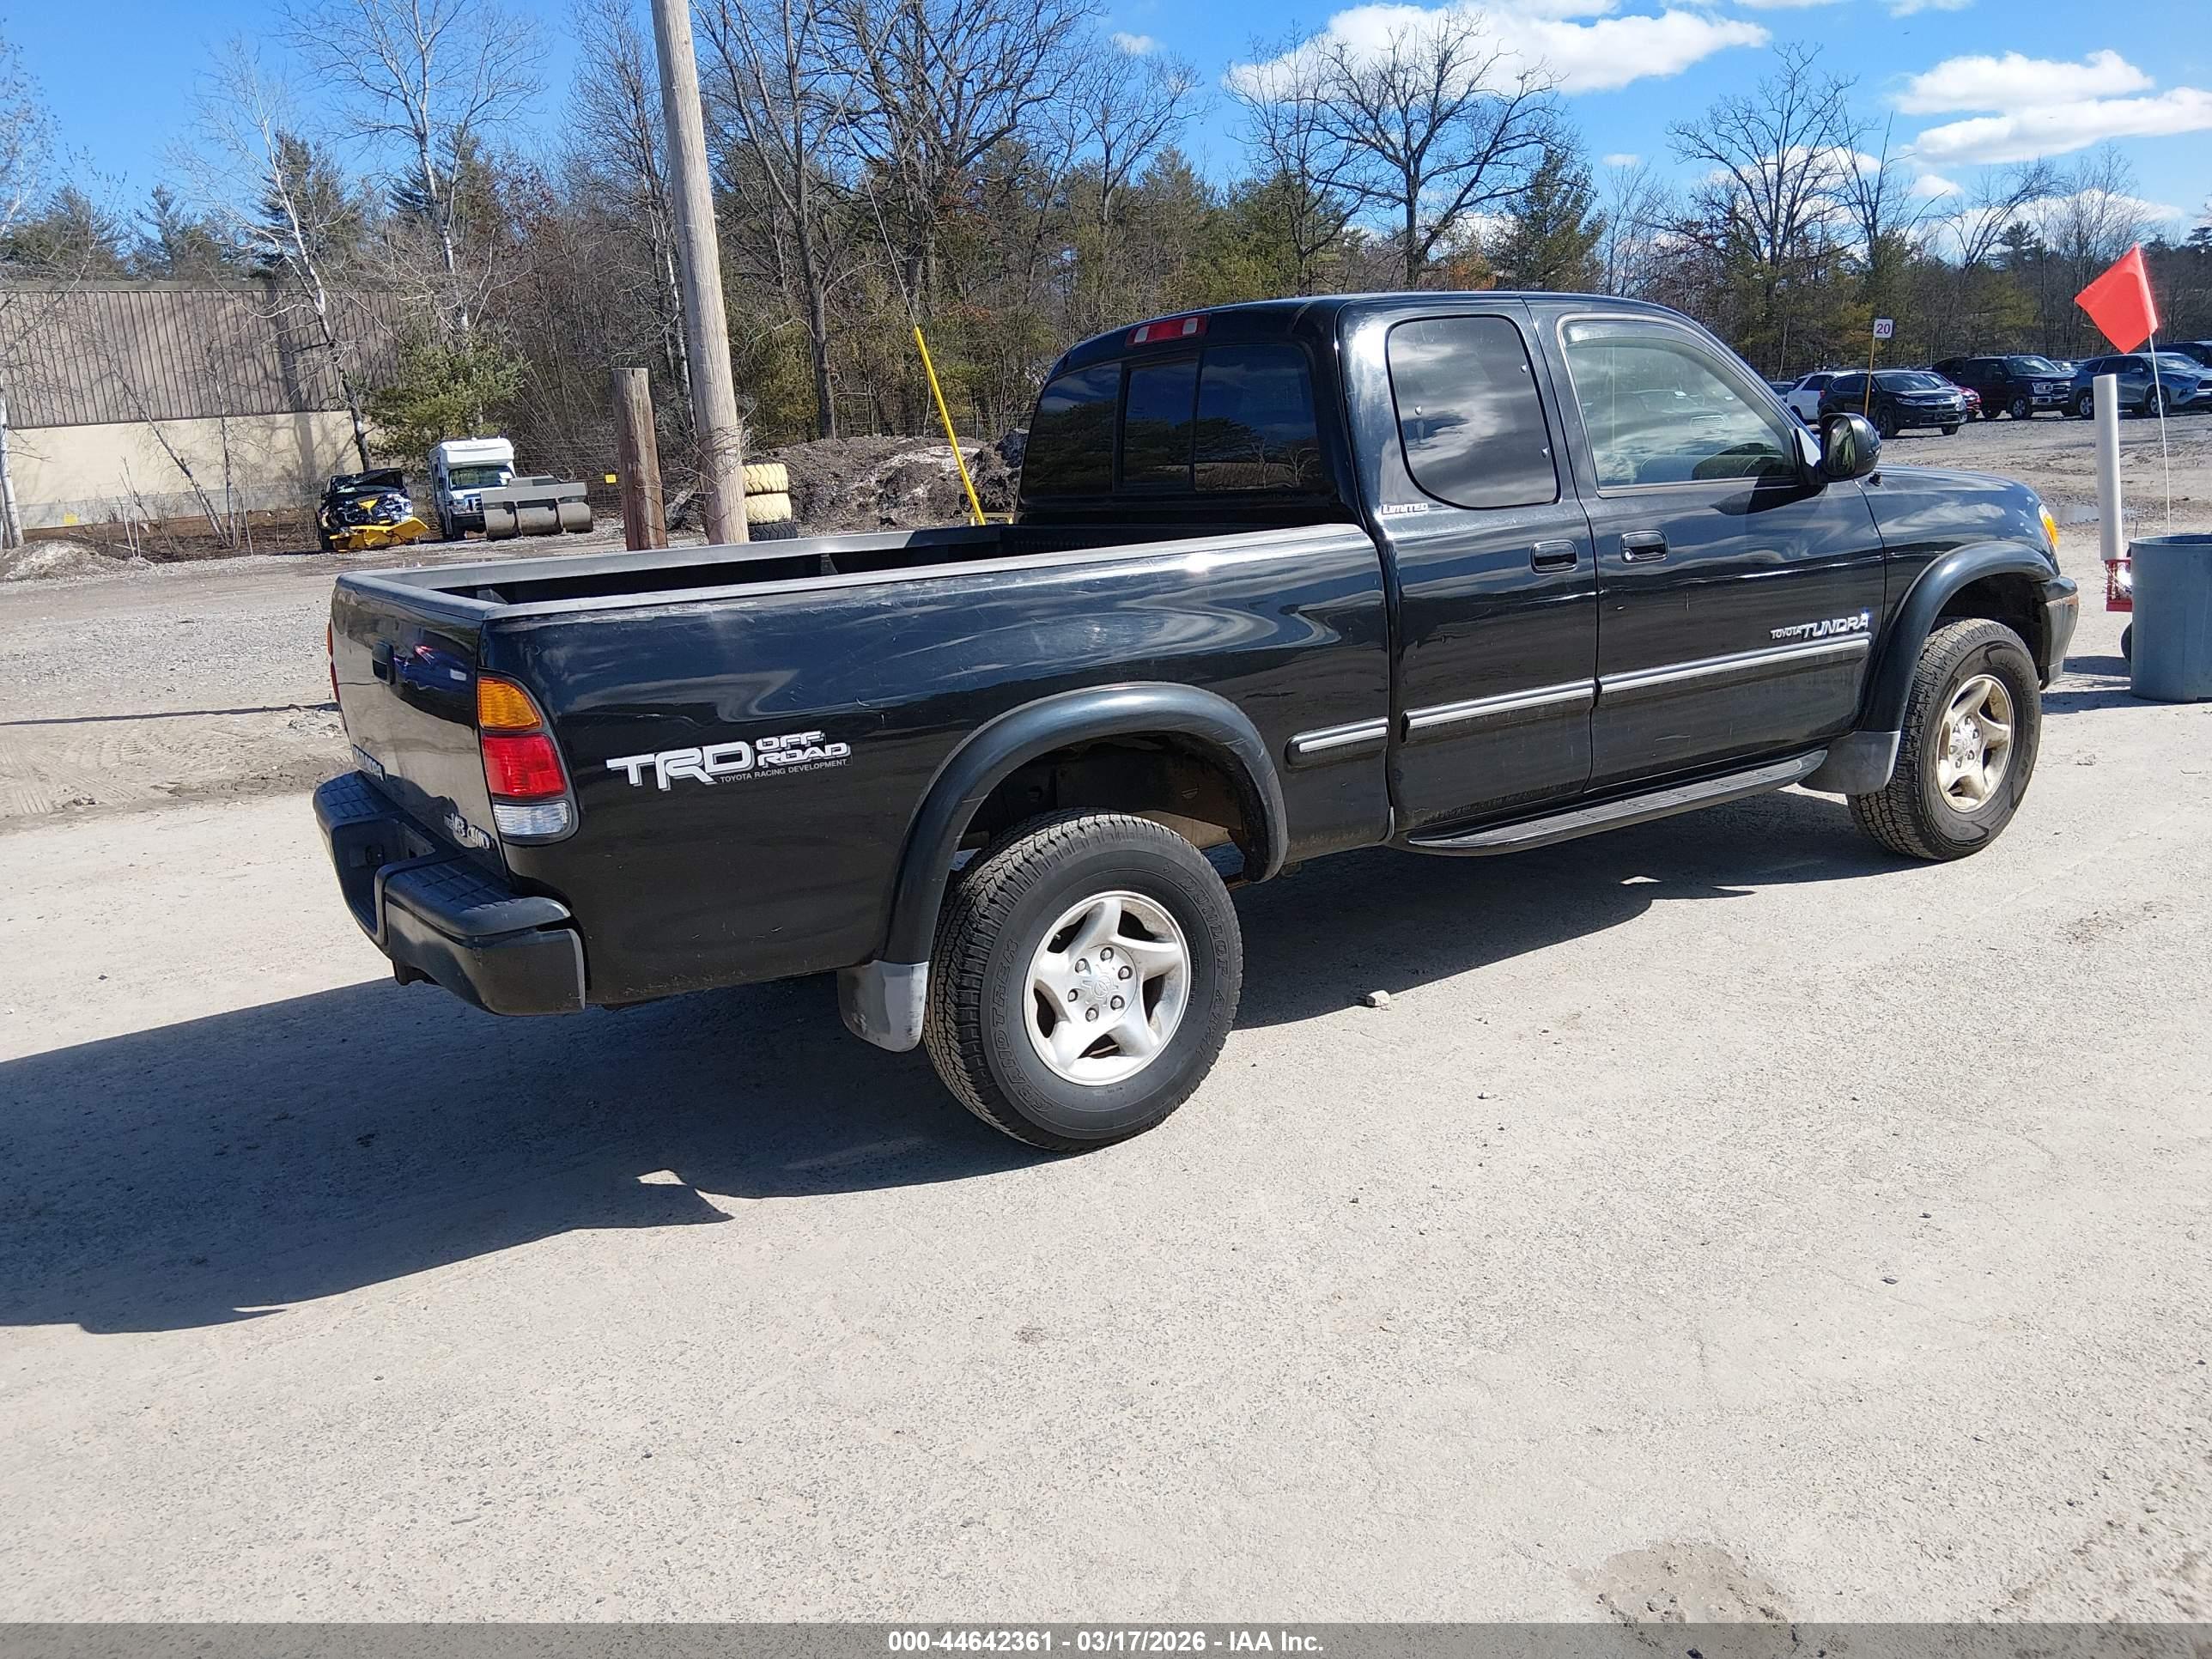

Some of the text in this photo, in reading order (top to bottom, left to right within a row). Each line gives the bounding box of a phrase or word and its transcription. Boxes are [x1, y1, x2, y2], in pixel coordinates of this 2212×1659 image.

[1876, 323, 1891, 334] 20
[1770, 612, 1869, 640] TOYOTA TUNDRA
[756, 730, 826, 751] OFF
[605, 741, 755, 792] TRD
[757, 742, 852, 768] ROAD
[720, 759, 848, 783] TOYOTA RACING DEVELOPMENT
[1177, 876, 1229, 977] DUNLOP
